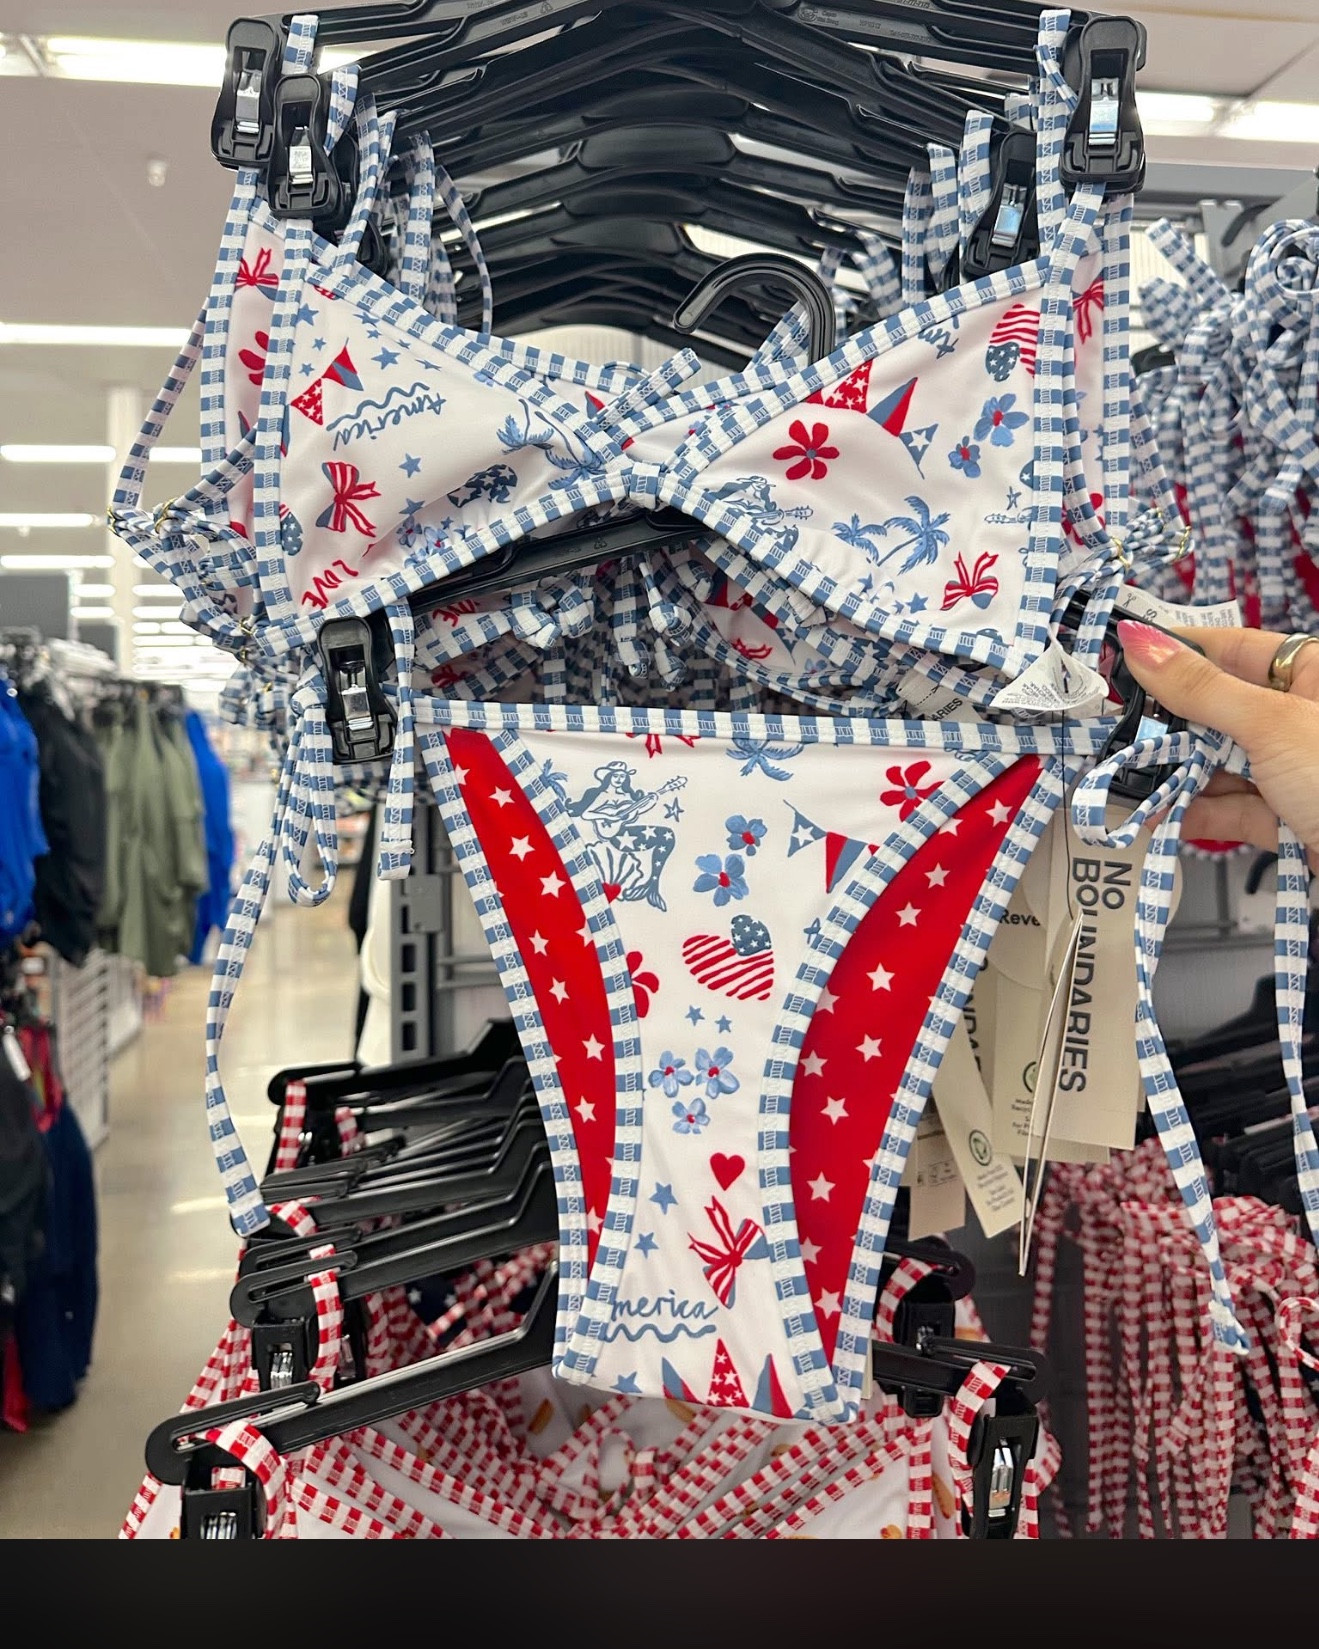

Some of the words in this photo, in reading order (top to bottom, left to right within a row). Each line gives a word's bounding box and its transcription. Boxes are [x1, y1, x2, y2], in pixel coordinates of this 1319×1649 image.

[333, 392, 447, 451] America
[931, 698, 963, 721] ARIES
[1102, 861, 1133, 909] NO
[1059, 857, 1101, 1092] BOUNDARIES
[610, 1288, 719, 1322] merica
